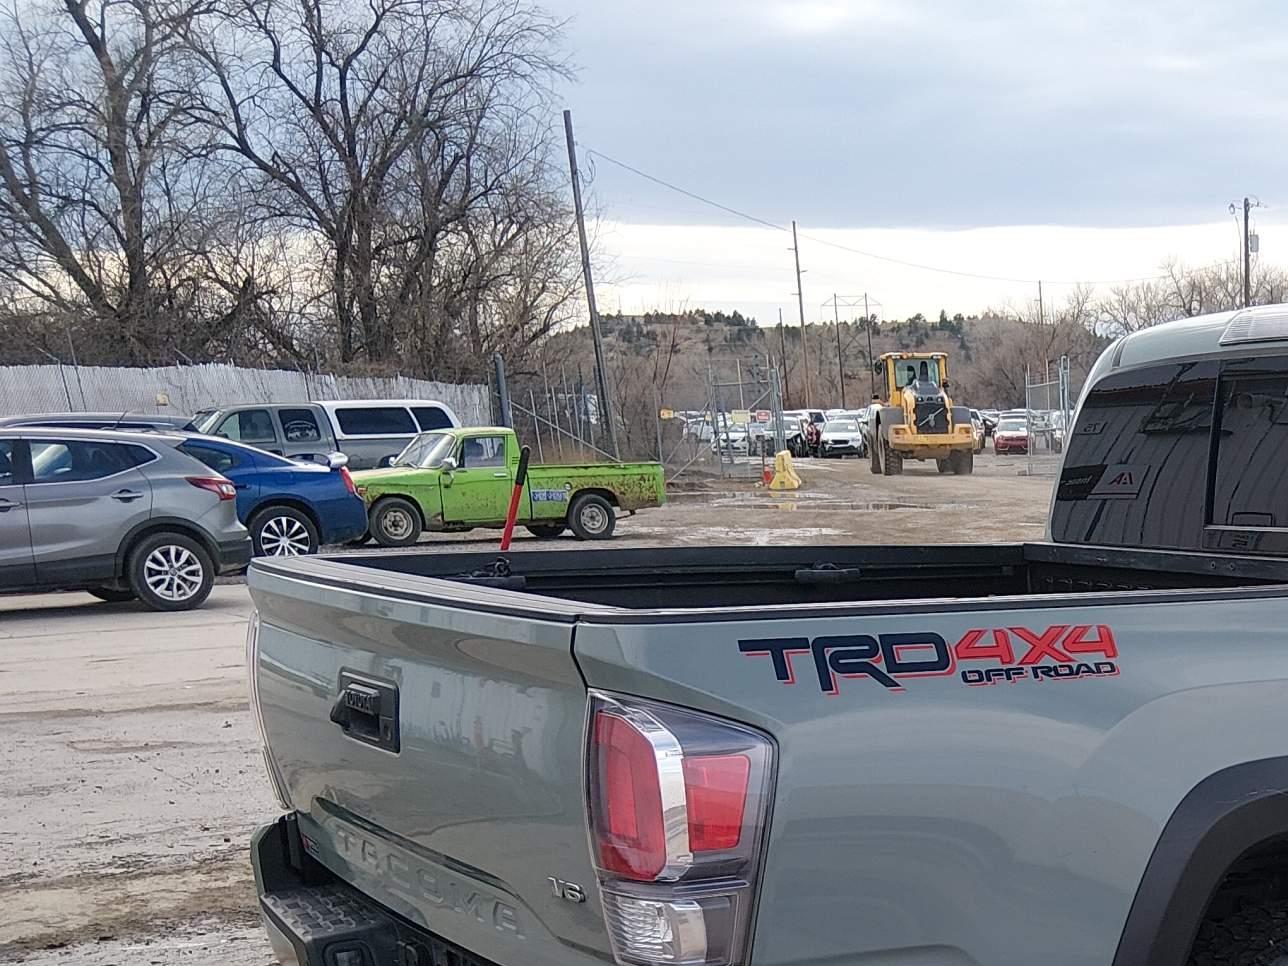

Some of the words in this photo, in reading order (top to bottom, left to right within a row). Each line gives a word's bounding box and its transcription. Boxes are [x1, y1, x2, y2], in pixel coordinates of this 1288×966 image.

[738, 632, 955, 694] TRD
[961, 667, 1025, 686] OFF
[1033, 661, 1119, 682] ROAD
[344, 689, 376, 714] TOYOTA
[335, 828, 528, 941] TACOMA
[547, 876, 585, 903] V6
